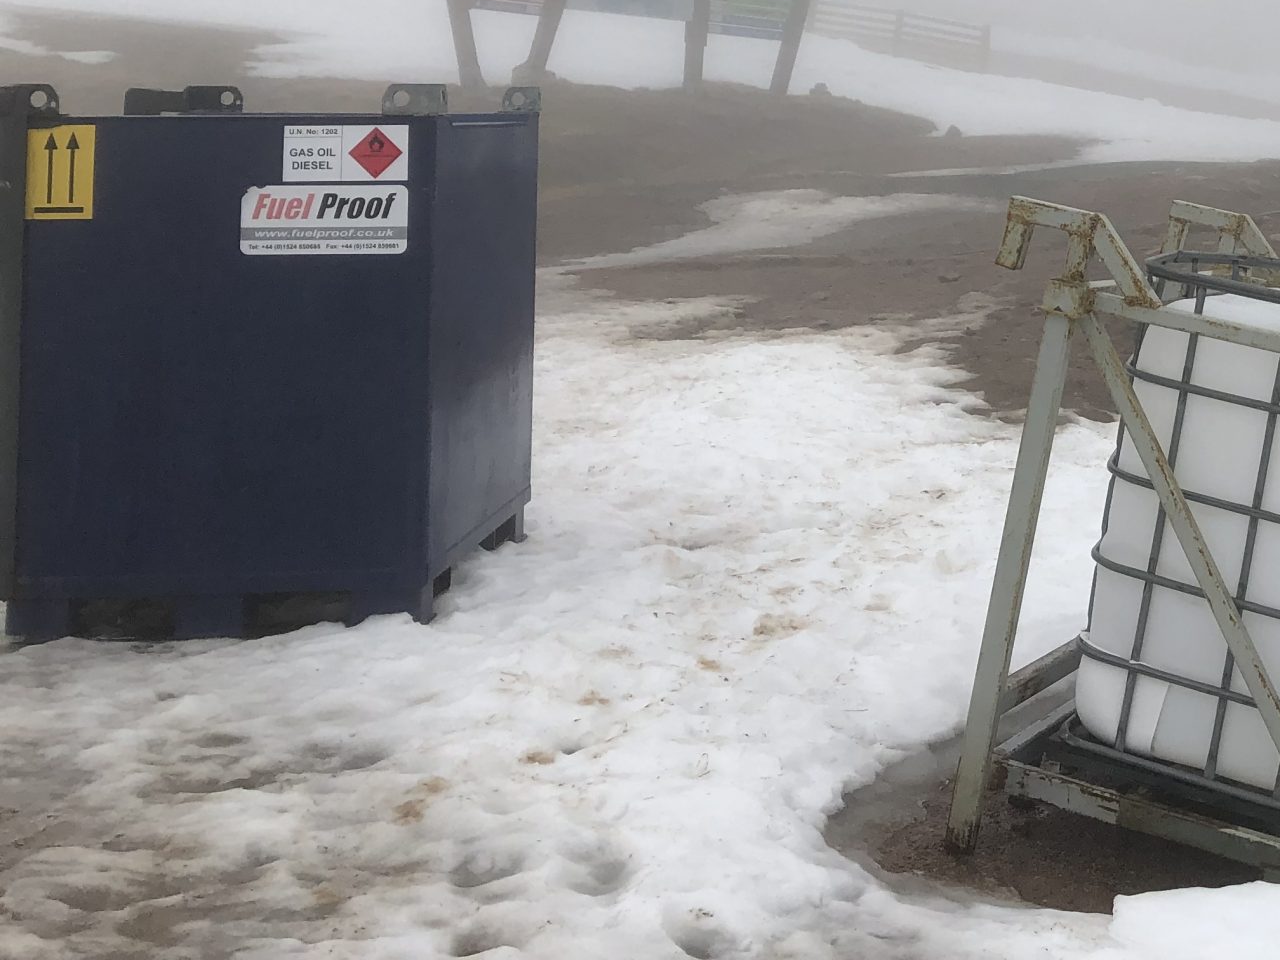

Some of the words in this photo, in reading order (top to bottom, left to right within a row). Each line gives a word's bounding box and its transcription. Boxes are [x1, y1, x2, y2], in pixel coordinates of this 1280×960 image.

[289, 147, 314, 157] GAS
[317, 147, 336, 157] OIL
[291, 161, 333, 170] DIESEL
[251, 192, 315, 220] Fuel
[316, 192, 397, 219] Proof
[254, 227, 394, 239] www.fuelproof.co.uk
